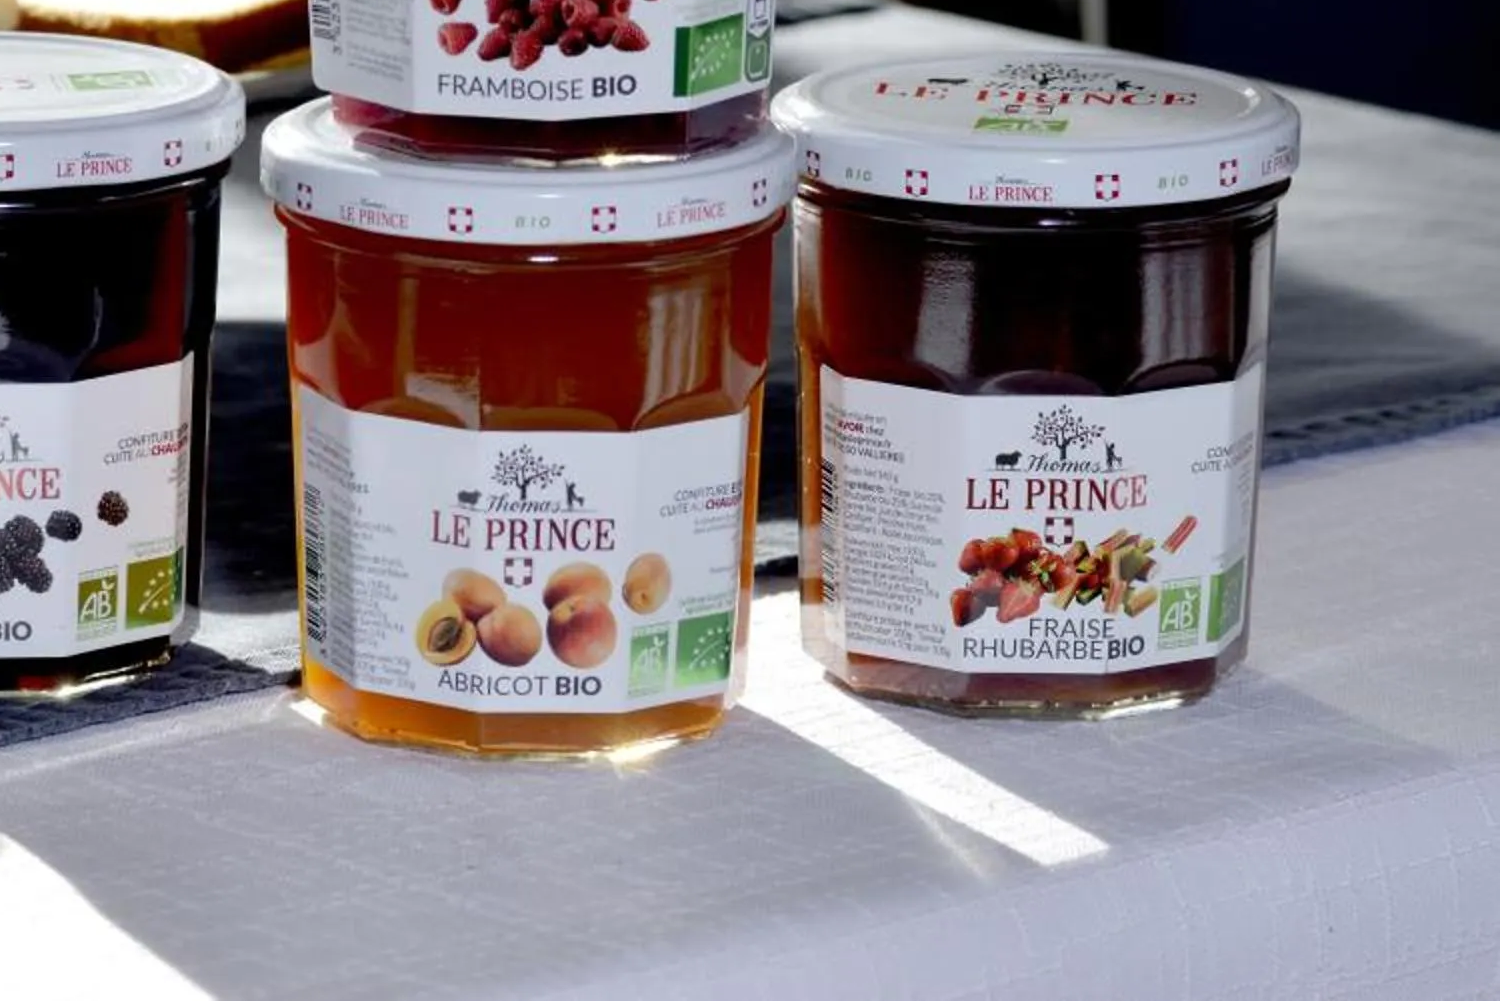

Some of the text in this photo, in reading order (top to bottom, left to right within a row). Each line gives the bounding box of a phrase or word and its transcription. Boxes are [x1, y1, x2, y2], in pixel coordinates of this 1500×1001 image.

[437, 74, 637, 102] FRAMBOISE BIO
[875, 82, 1197, 106] LE PRINCE
[57, 158, 132, 178] LE PRINCE
[845, 167, 873, 183] BIO
[969, 184, 1053, 202] LE PRINCE
[1157, 174, 1189, 189] BIO
[339, 205, 410, 230] LE PRINCE
[514, 216, 551, 229] BIO
[656, 202, 726, 229] LE PRINCE
[1024, 453, 1103, 474] Thomas
[484, 494, 561, 514] Thomas
[966, 474, 1148, 512] LE PRINCE
[431, 510, 615, 551] LE PRINCE
[80, 589, 112, 621] AB
[1161, 601, 1195, 633] AB
[1029, 618, 1115, 639] FRAISE
[963, 636, 1145, 661] RHUBARBE BIO
[438, 670, 602, 697] ABRICOT BIO
